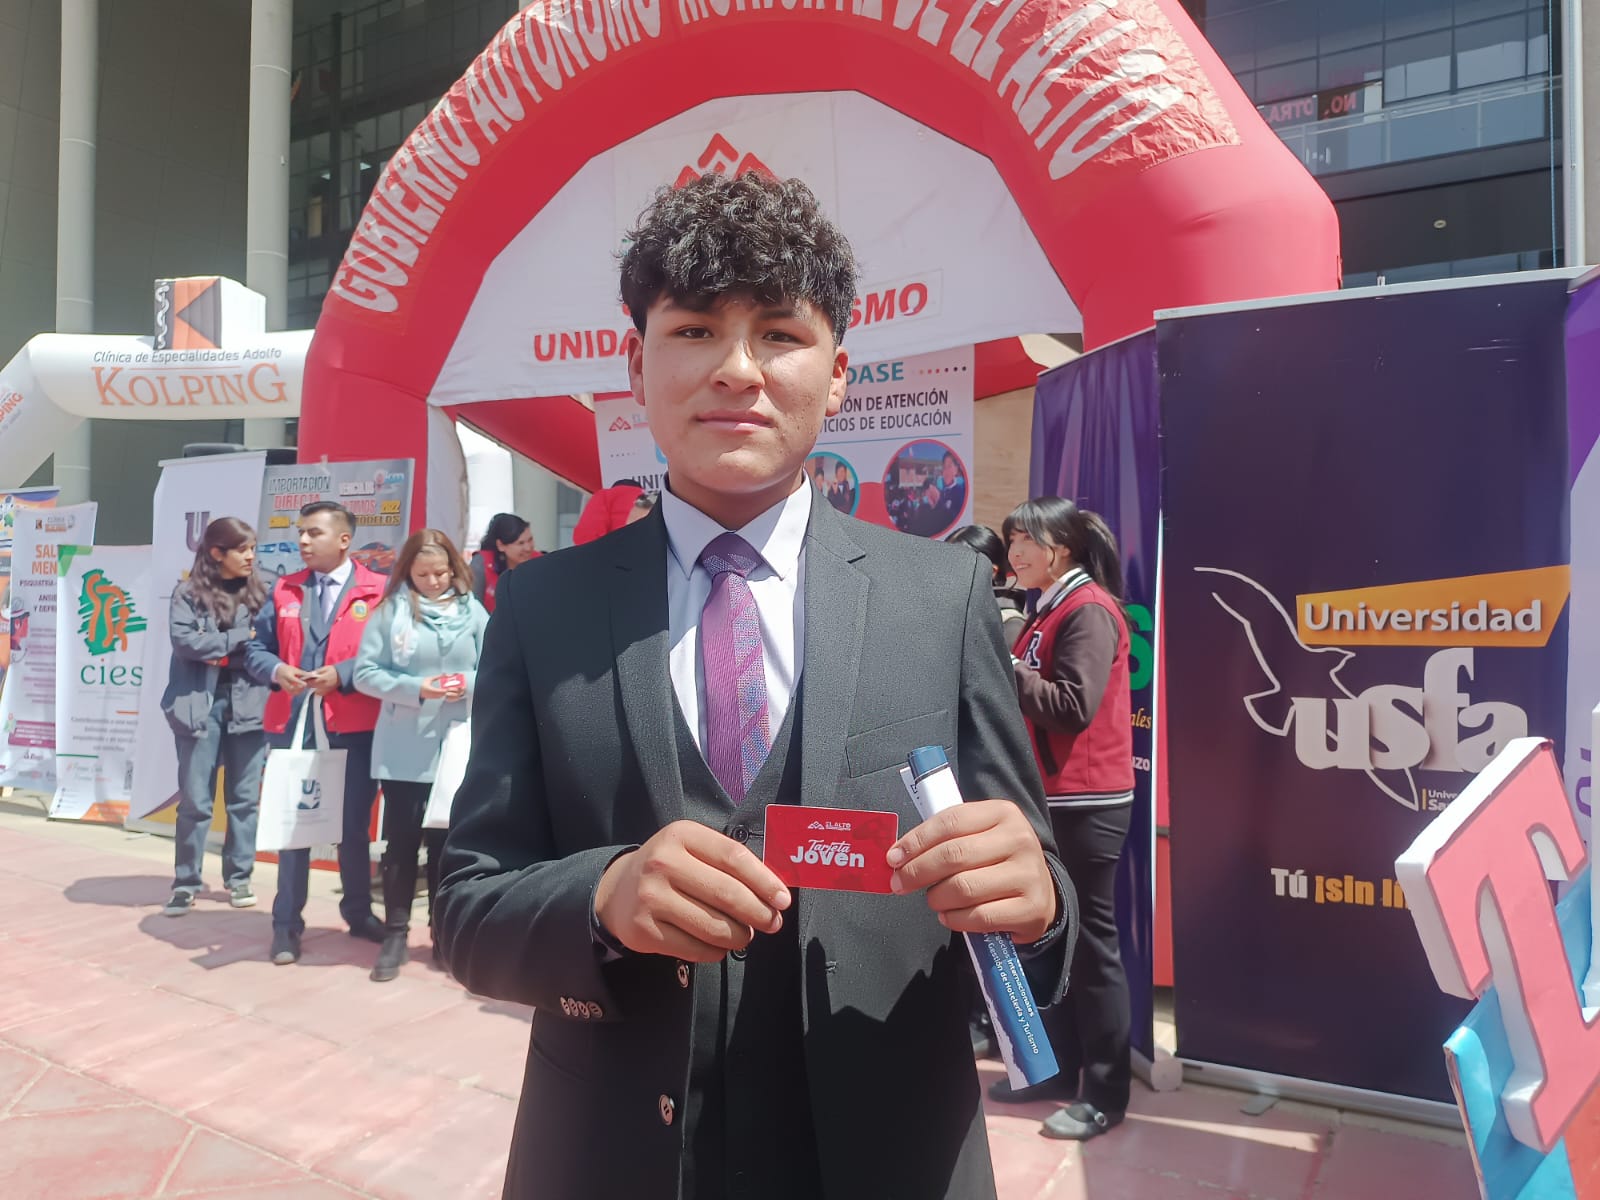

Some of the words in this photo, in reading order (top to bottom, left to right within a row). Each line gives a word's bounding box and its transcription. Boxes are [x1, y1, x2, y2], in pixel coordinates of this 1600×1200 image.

[332, 97, 480, 313] GOBIERNO
[997, 0, 1185, 180] ALTO
[94, 351, 131, 363] Clínica
[135, 351, 148, 362] de
[152, 349, 239, 365] Especialidades
[243, 348, 281, 360] Adolfo
[91, 363, 288, 406] KOLPING
[866, 397, 882, 411] DE
[885, 388, 949, 409] ATENCIÓN
[860, 416, 875, 430] DE
[880, 409, 951, 430] EDUCACIÓN
[1304, 600, 1542, 632] Universidad
[1291, 647, 1528, 773] usfa
[808, 839, 851, 856] Tarjeta
[1270, 867, 1308, 898] Tú
[987, 942, 1003, 970] Gestión
[1000, 970, 1009, 982] de
[1007, 959, 1034, 1017] Internacionales
[1004, 982, 1023, 1016] Hotelería
[1022, 1021, 1039, 1055] Turismo
